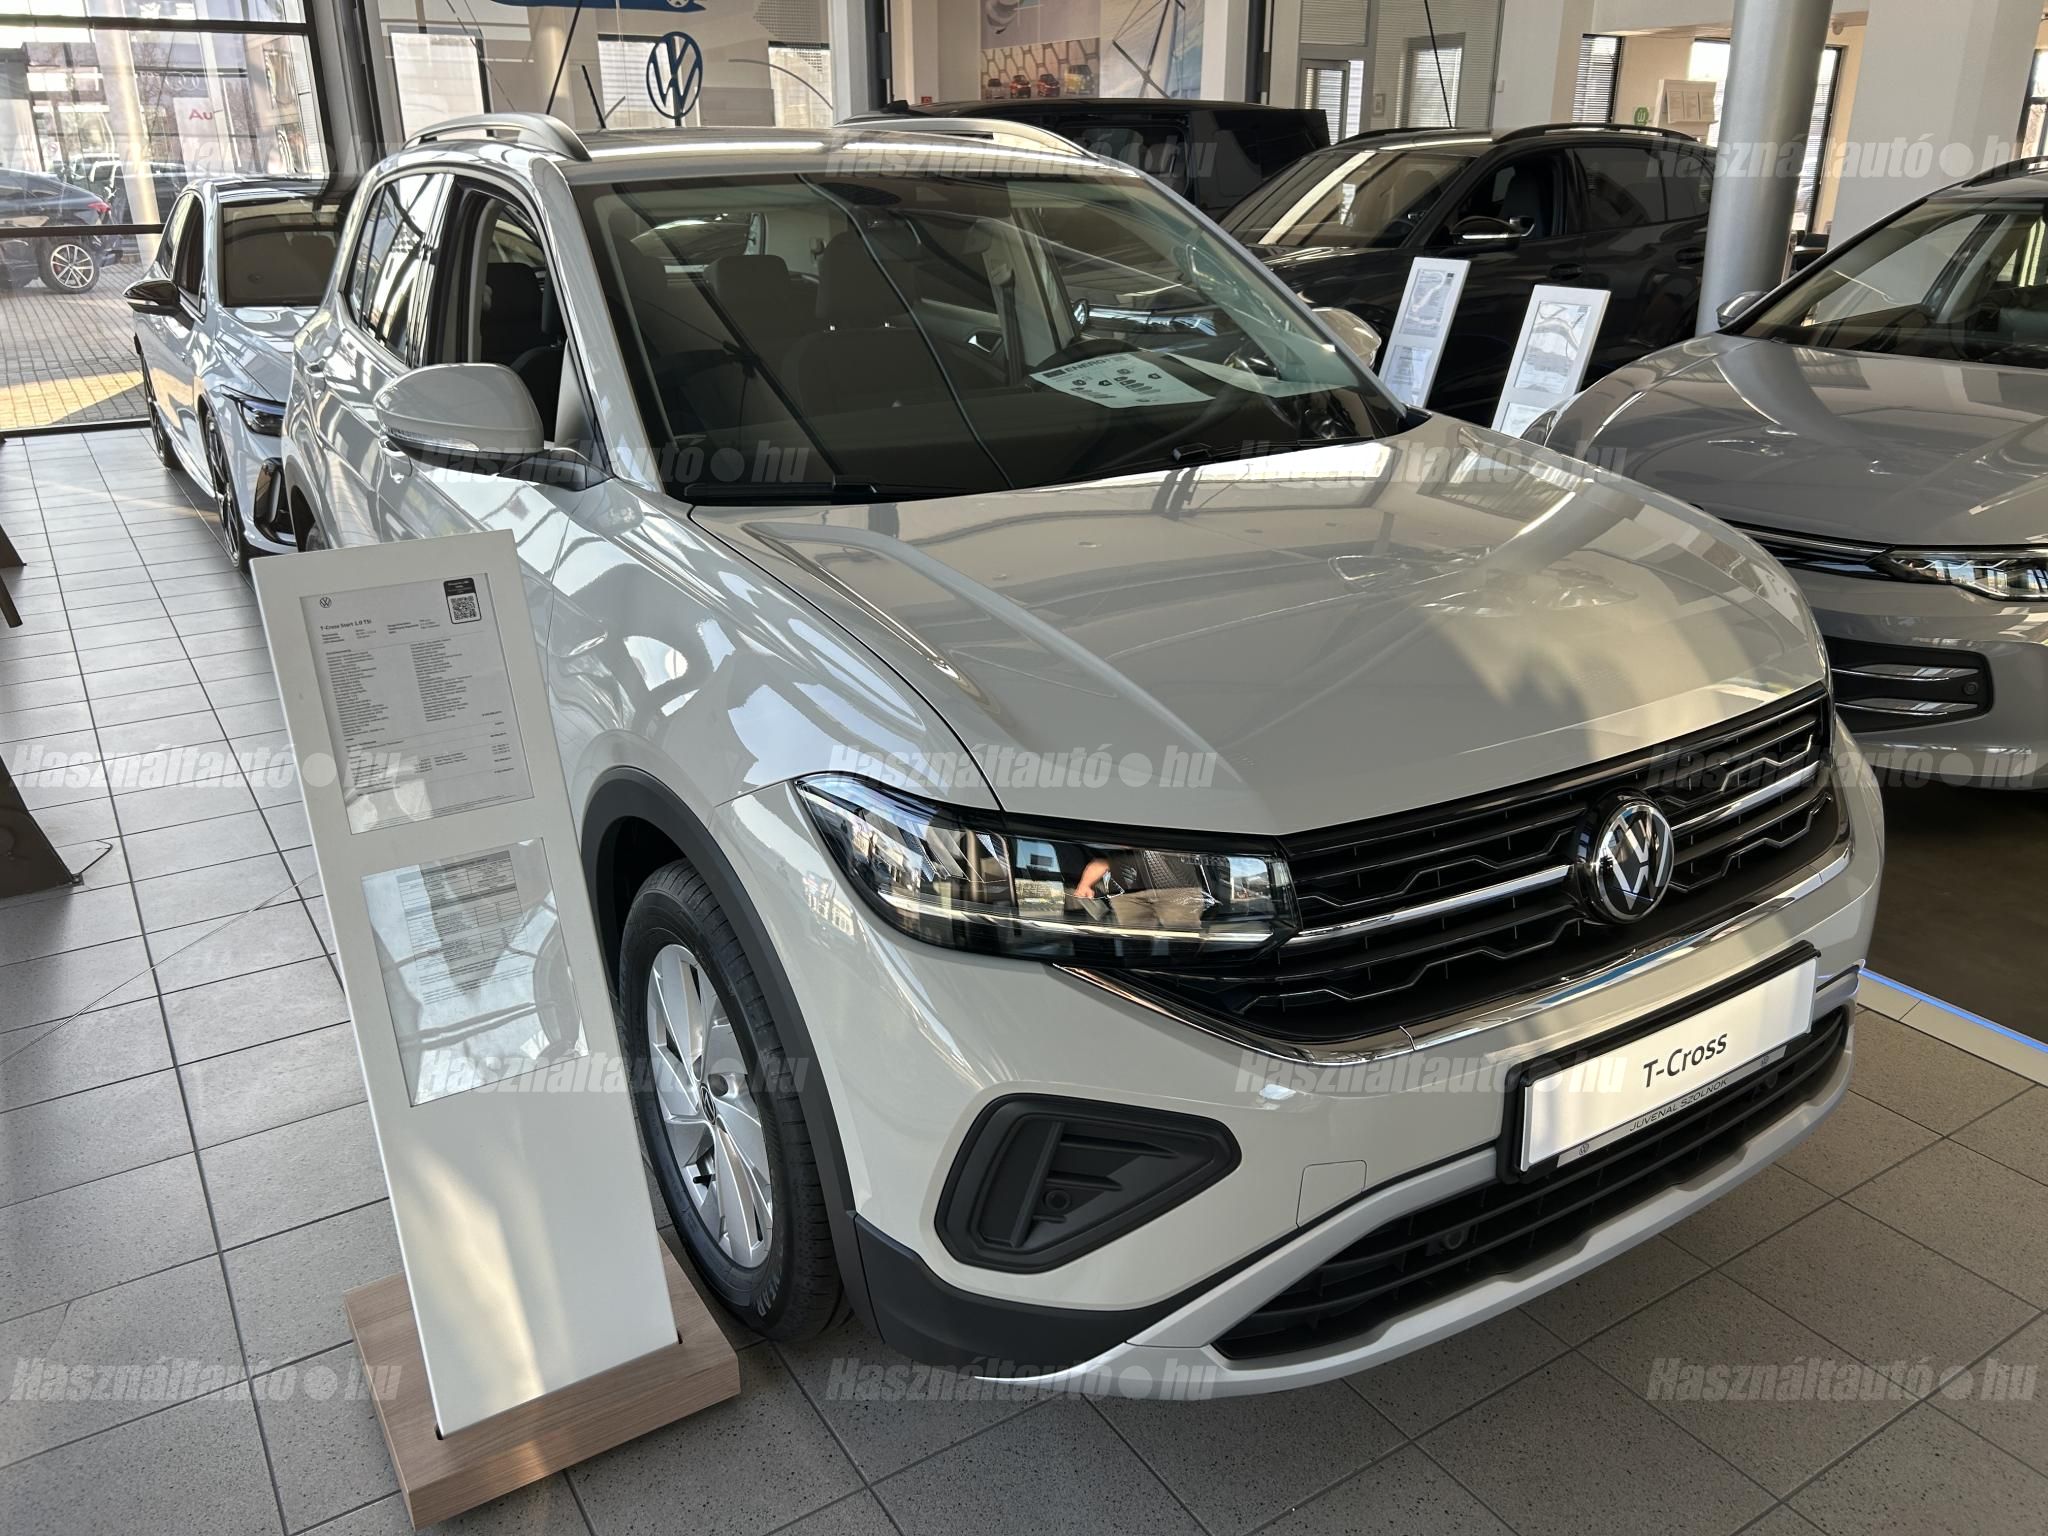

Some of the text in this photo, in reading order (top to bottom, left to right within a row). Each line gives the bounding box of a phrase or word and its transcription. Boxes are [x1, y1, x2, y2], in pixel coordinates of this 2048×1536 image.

[188, 108, 214, 121] Au
[1643, 1033, 1728, 1088] T-Cross
[1630, 1078, 1728, 1131] JUVENAL SZOLNOK
